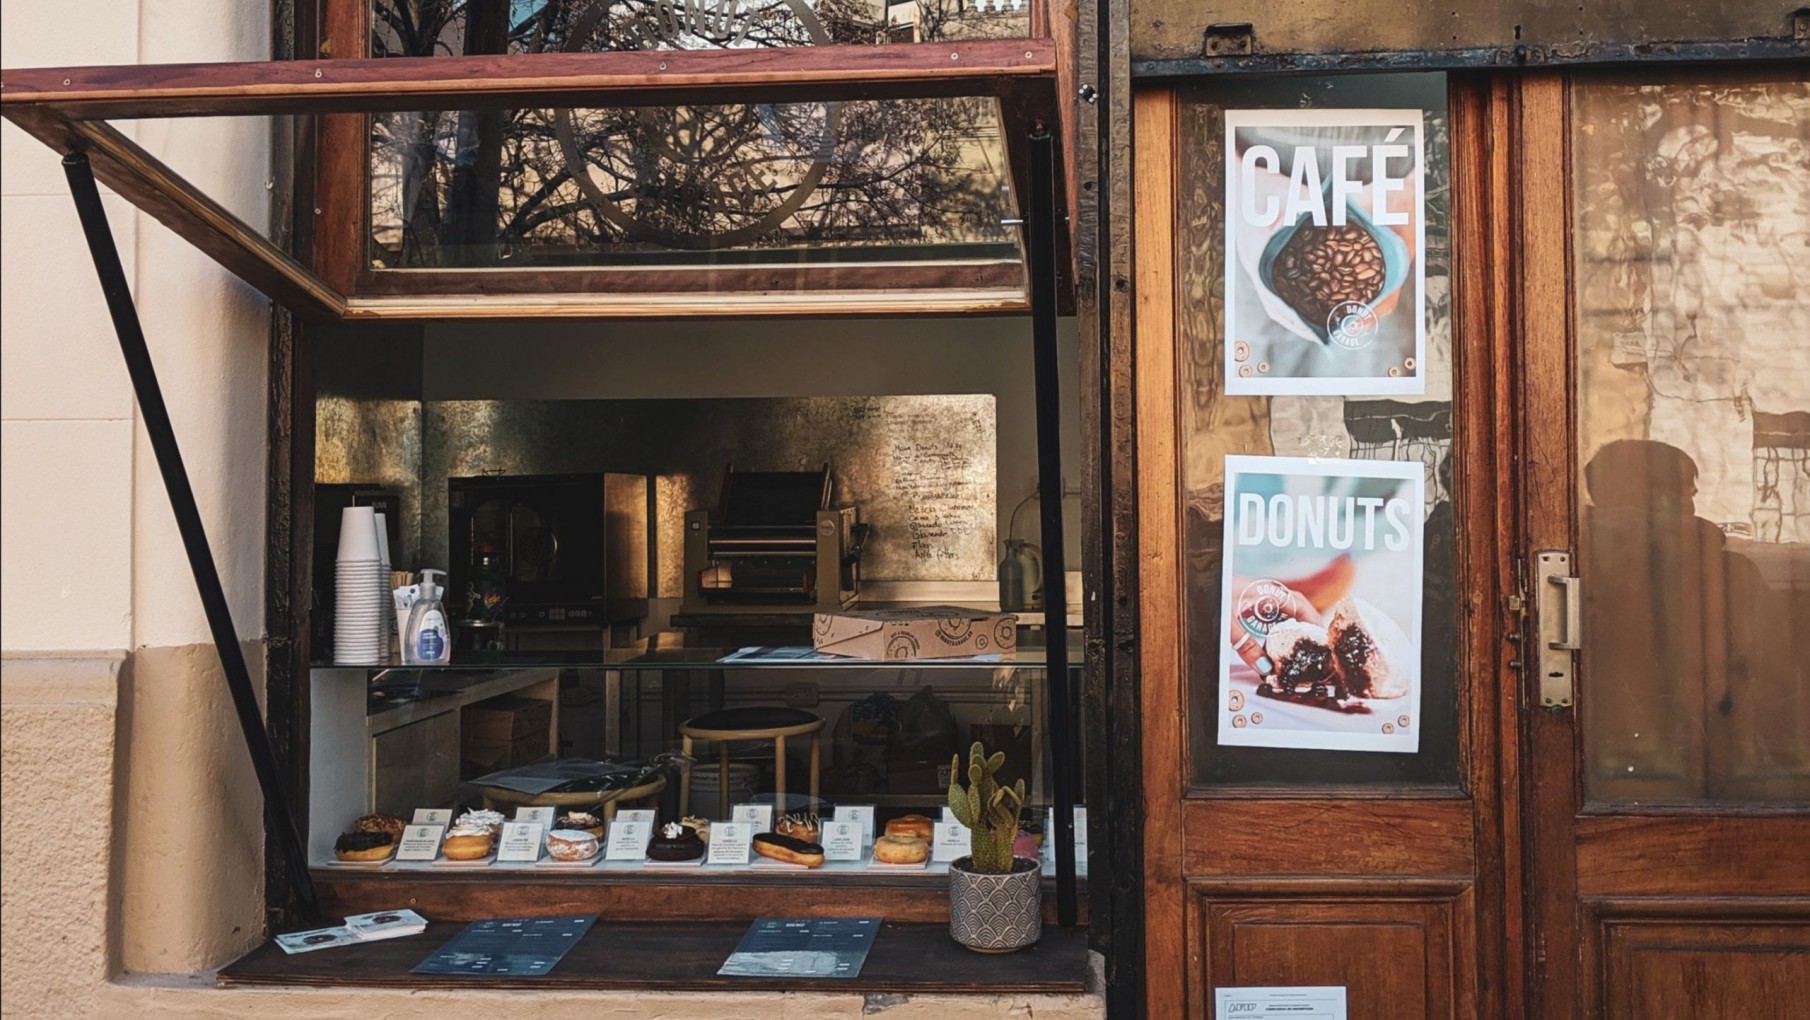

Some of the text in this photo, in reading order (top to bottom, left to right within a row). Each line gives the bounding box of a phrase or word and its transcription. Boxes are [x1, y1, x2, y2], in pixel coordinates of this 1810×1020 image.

[1241, 127, 1409, 227] CAFÉ
[1346, 304, 1373, 321] DONUT
[1332, 329, 1360, 346] GARAGE
[1238, 492, 1411, 551] DONUTS
[1257, 584, 1285, 600] DONUT
